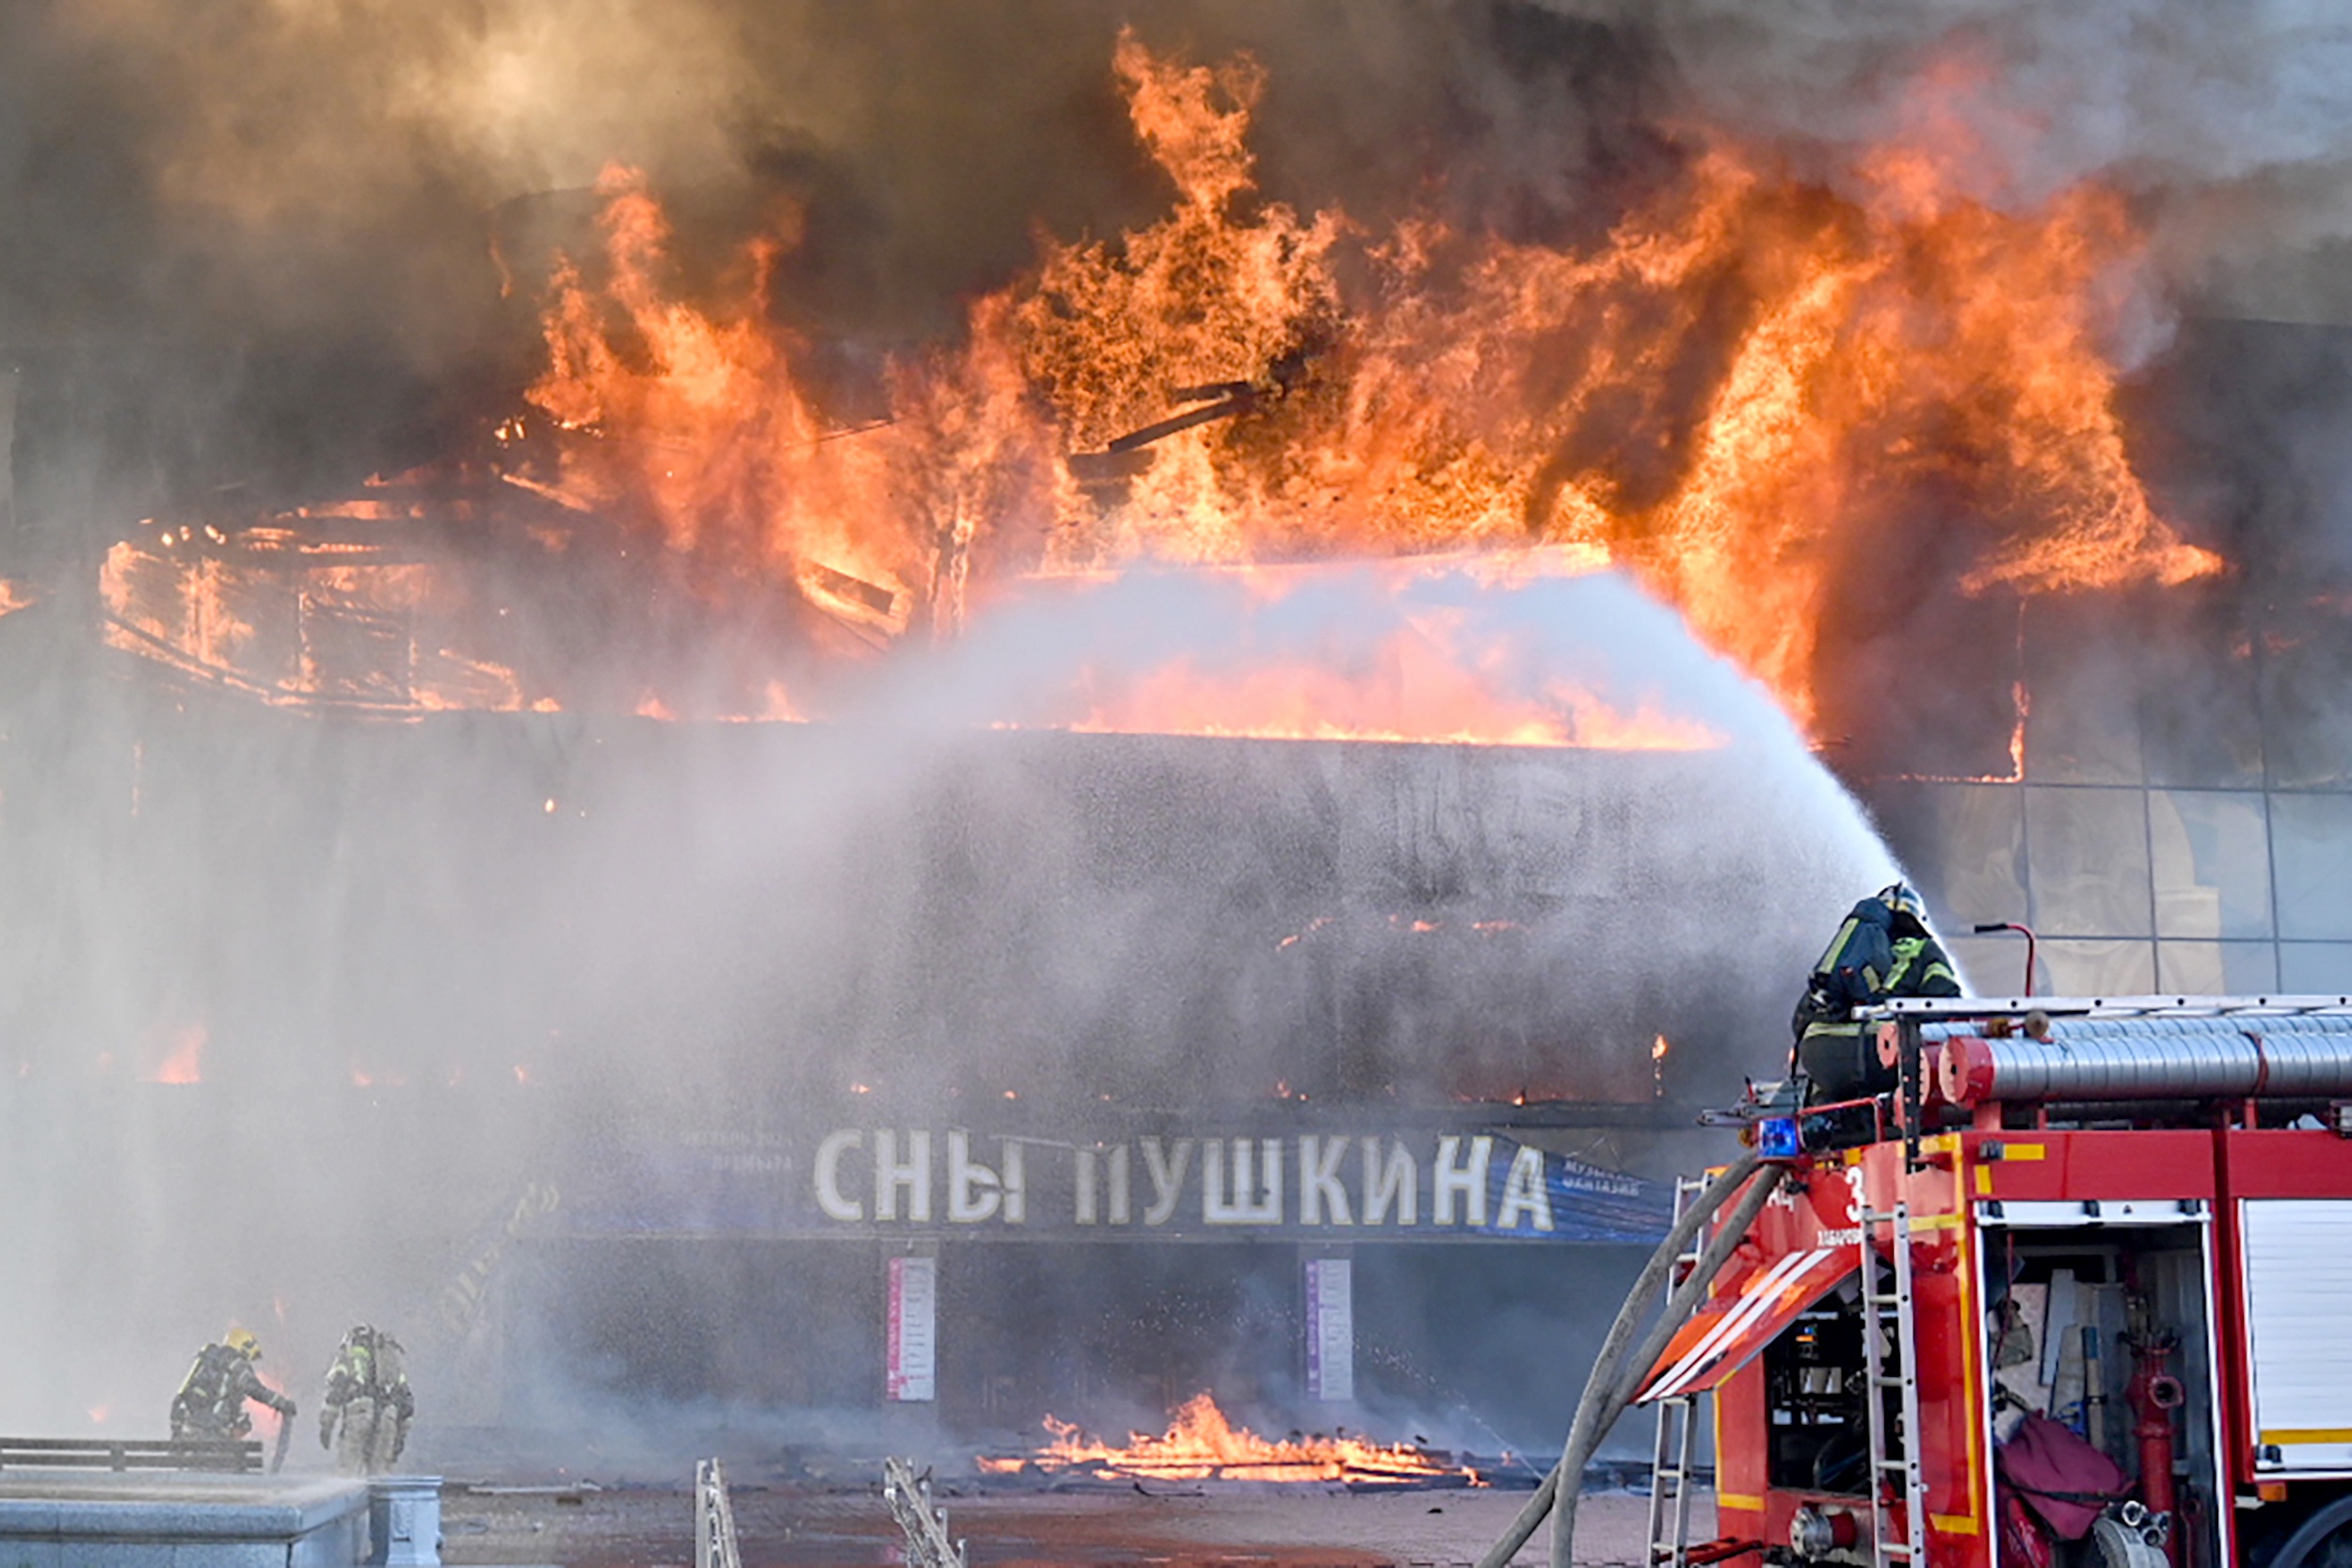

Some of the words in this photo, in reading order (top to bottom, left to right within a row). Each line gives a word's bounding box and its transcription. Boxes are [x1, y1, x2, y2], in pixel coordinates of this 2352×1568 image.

[814, 1128, 1025, 1224] СНЫ
[1075, 1134, 1554, 1231] ПУШКИНА
[1846, 1166, 1865, 1224] 3
